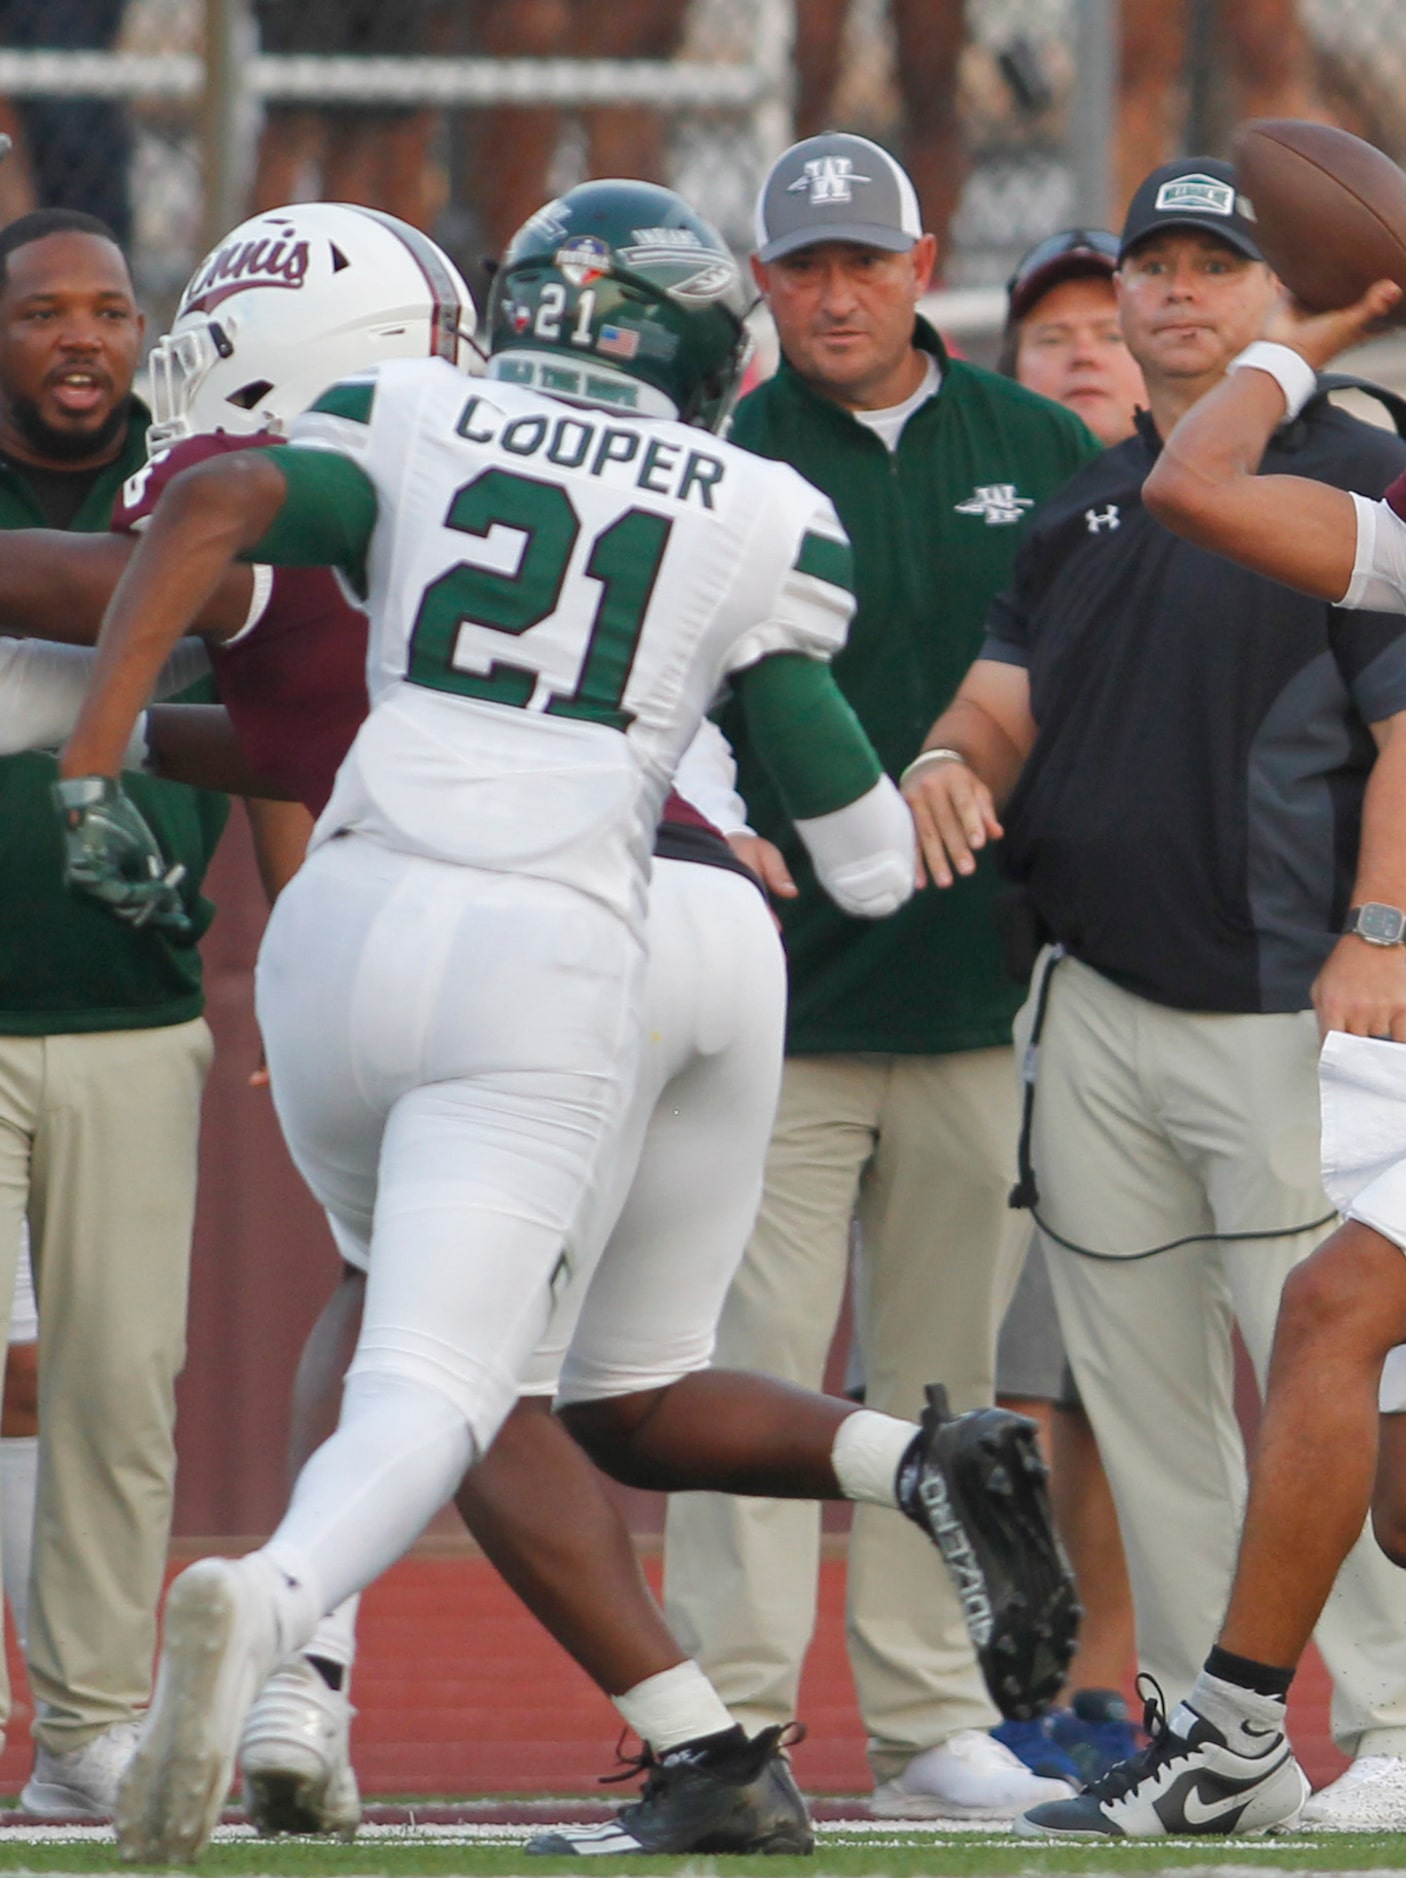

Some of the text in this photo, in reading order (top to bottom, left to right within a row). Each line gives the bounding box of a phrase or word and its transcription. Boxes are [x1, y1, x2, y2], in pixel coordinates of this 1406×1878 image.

[534, 283, 596, 345] 21
[455, 394, 725, 511] COOPER
[403, 464, 675, 734] 21
